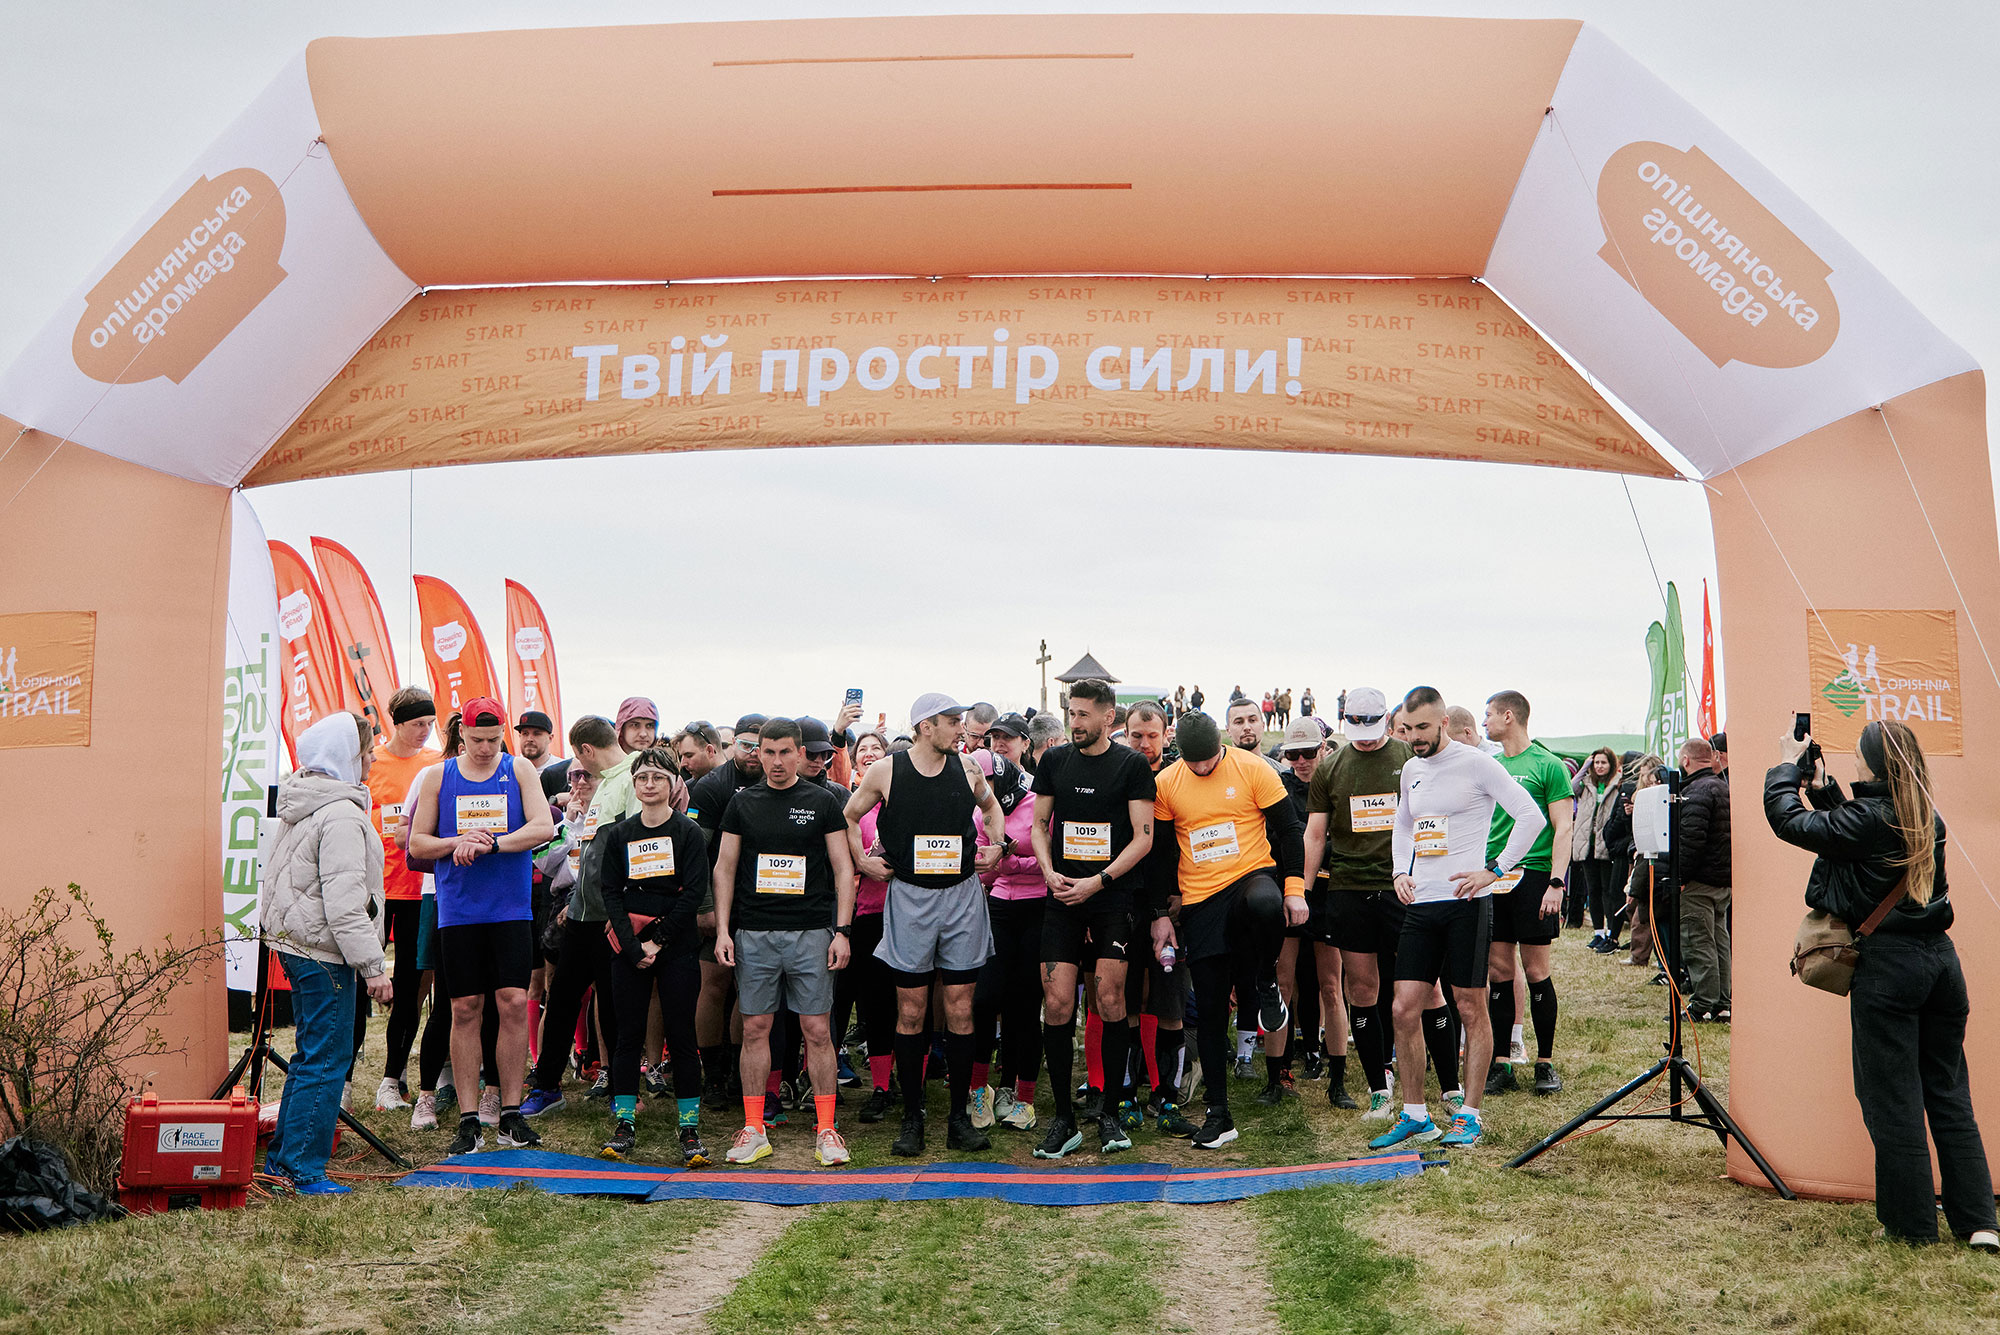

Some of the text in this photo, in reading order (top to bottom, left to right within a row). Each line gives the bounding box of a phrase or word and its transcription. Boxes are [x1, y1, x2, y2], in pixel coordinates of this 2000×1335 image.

[653, 295, 718, 309] START
[776, 291, 841, 303] START
[903, 291, 968, 303] START
[1029, 288, 1096, 300] START
[1158, 290, 1224, 302] START
[1288, 291, 1355, 303] START
[531, 299, 596, 312] START
[1417, 294, 1483, 311] START
[419, 304, 477, 322] START
[706, 313, 770, 328] START
[831, 312, 898, 324] START
[958, 310, 1025, 322] START
[1087, 310, 1154, 323] START
[1217, 312, 1284, 325] START
[583, 319, 648, 333] START
[1347, 314, 1415, 330] START
[465, 324, 527, 341] START
[897, 334, 965, 347] START
[1026, 333, 1094, 347] START
[365, 334, 414, 351] TART
[771, 336, 836, 350] START
[1156, 334, 1224, 348] START
[1302, 337, 1355, 353] TART
[526, 347, 574, 362] STAR
[1417, 343, 1484, 361] START
[412, 353, 471, 371] START
[573, 328, 1302, 407] Твій простір сили!
[1346, 366, 1415, 384] START
[1477, 373, 1544, 392] START
[462, 375, 522, 393] START
[350, 384, 408, 403] START
[524, 398, 583, 415] START
[1417, 396, 1484, 415] START
[408, 405, 468, 423] START
[824, 412, 891, 427] START
[952, 411, 1021, 426] START
[1082, 412, 1151, 428] START
[1536, 404, 1603, 425] START
[299, 415, 355, 435] START
[578, 422, 640, 438] START
[699, 415, 763, 432] START
[1214, 416, 1282, 432] START
[1345, 421, 1413, 438] START
[462, 429, 521, 446] START
[1476, 428, 1544, 447] START
[349, 436, 407, 456] START
[1596, 437, 1649, 457] STAR
[261, 448, 304, 466] TART
[22, 675, 82, 688] OPISHNIA
[1886, 679, 1951, 691] OPISHNIA
[0, 690, 80, 718] TRAIL
[1858, 694, 1953, 722] TRAIL
[1362, 798, 1385, 808] 1144
[1075, 826, 1097, 836] 1019
[1418, 820, 1436, 830] 1074
[638, 842, 659, 853] 1016
[926, 840, 951, 849] 1072
[768, 858, 794, 868] 1097
